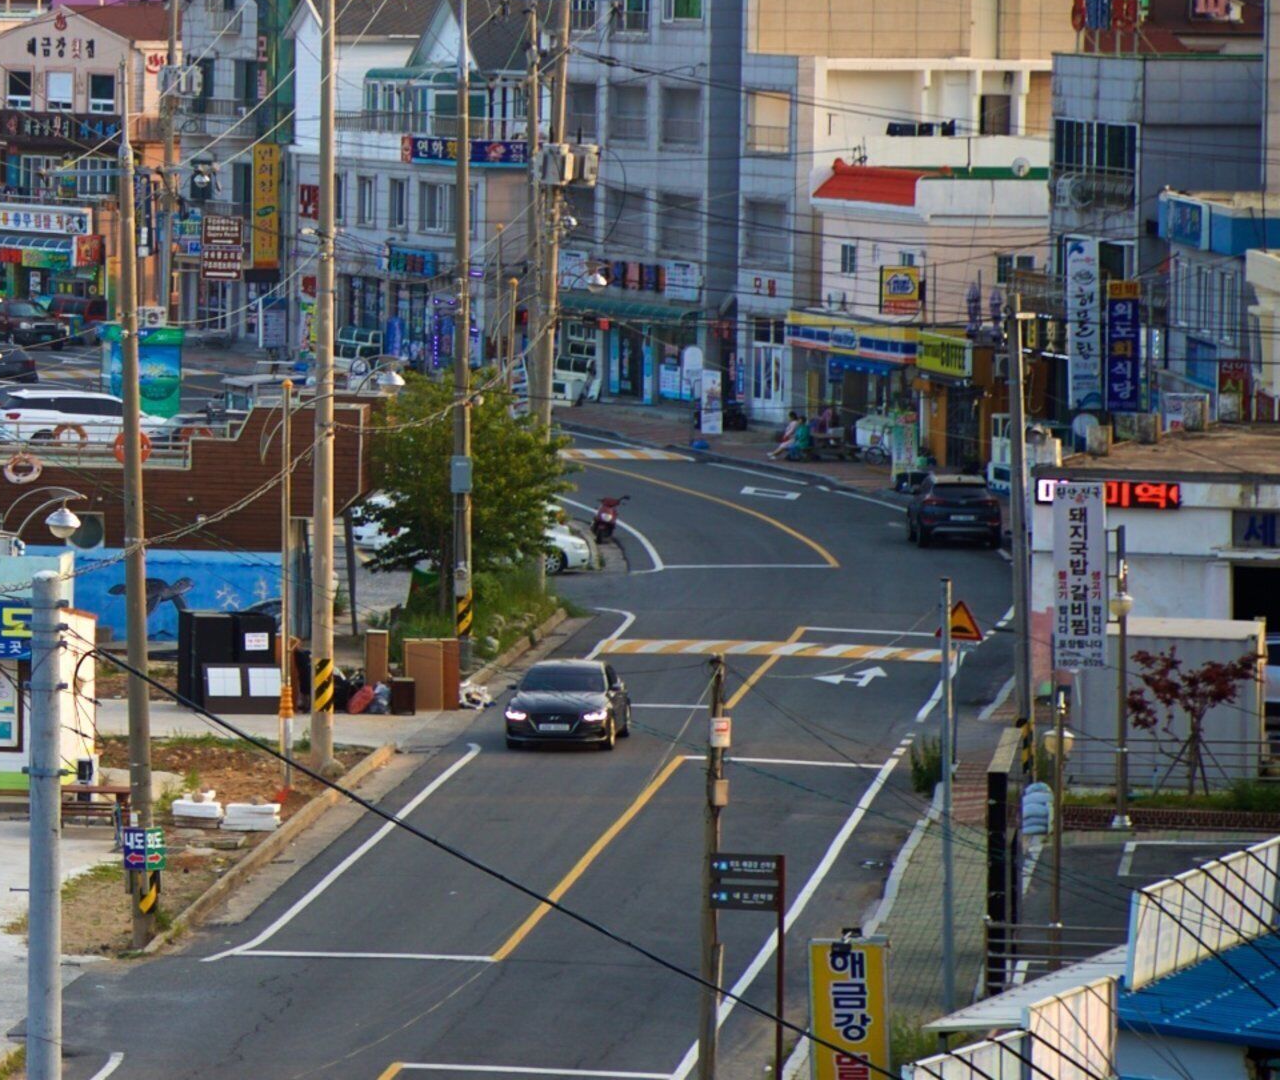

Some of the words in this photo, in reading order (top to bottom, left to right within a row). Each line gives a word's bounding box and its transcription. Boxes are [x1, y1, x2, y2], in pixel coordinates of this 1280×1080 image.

[754, 277, 776, 297] 모텔
[1111, 301, 1136, 399] 외도회식당
[9, 642, 23, 655] 곳
[124, 832, 145, 850] 내도
[830, 951, 873, 1042] 해금강
